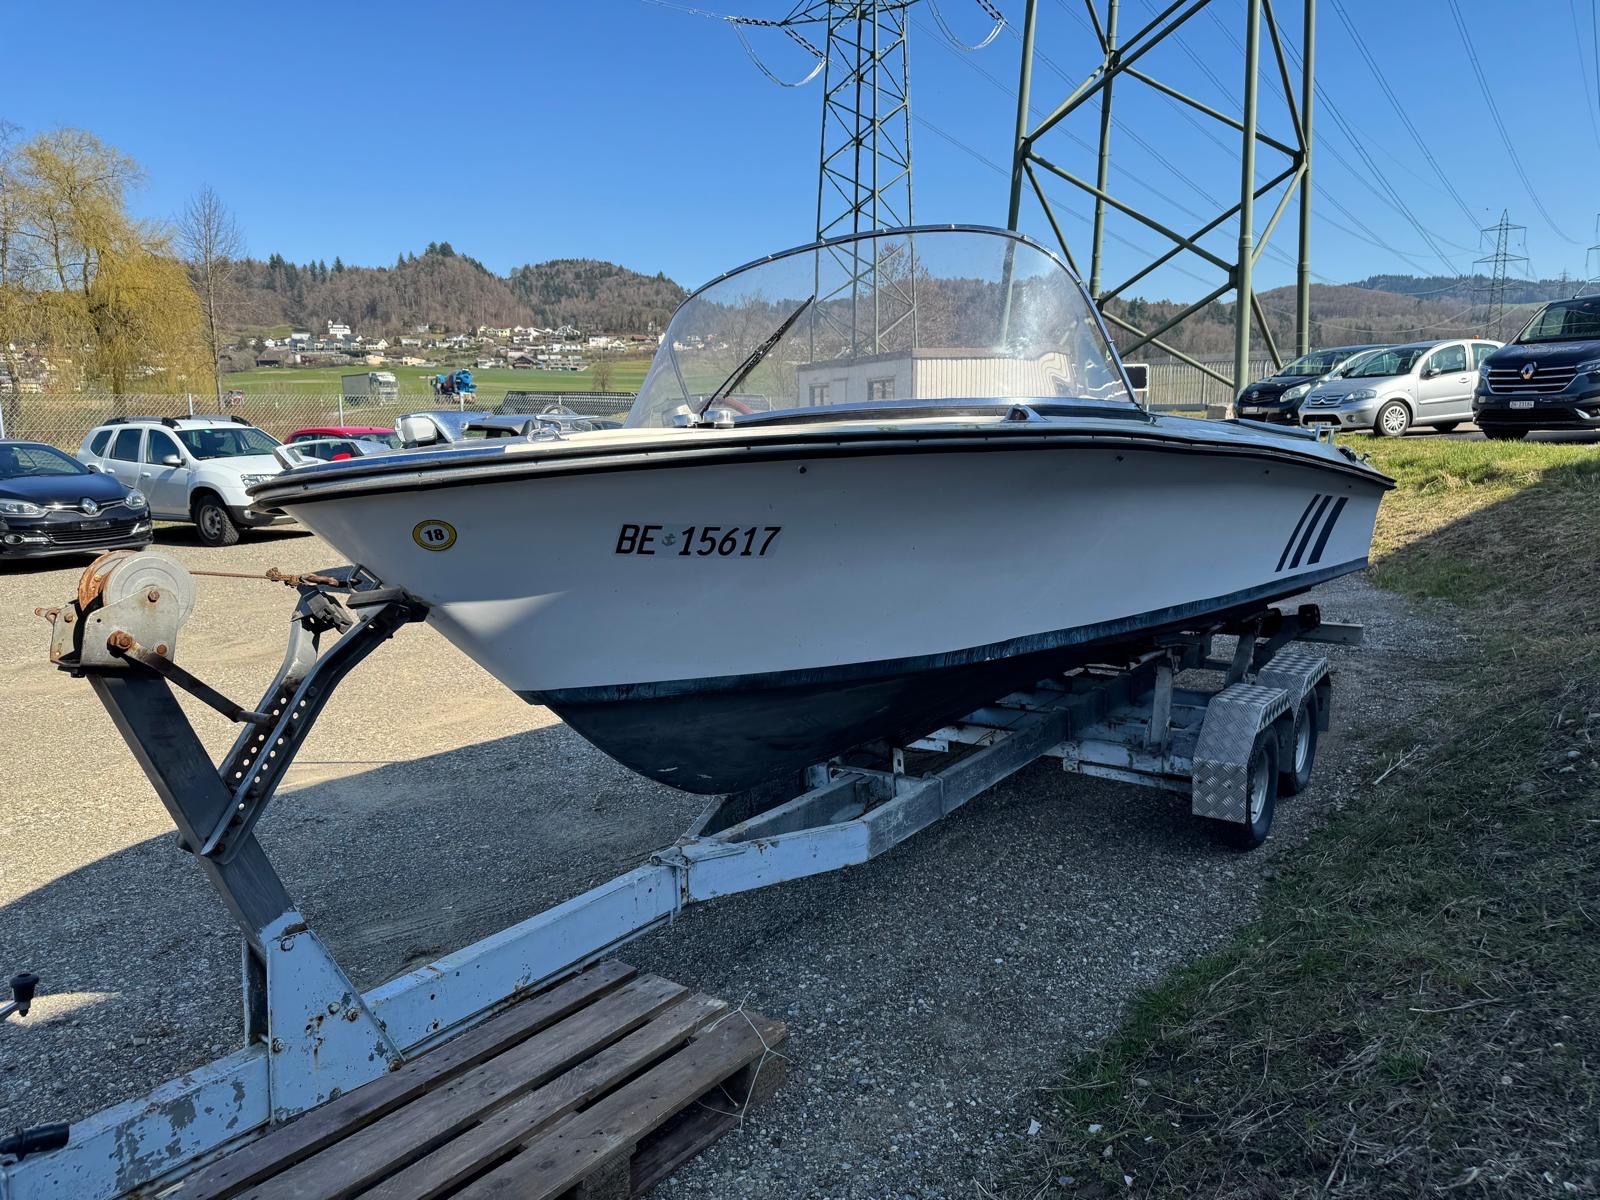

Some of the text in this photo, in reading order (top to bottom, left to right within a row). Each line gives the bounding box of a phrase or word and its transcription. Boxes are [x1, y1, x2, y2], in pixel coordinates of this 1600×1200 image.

[424, 528, 445, 542] 18
[615, 524, 782, 556] BE 15617
